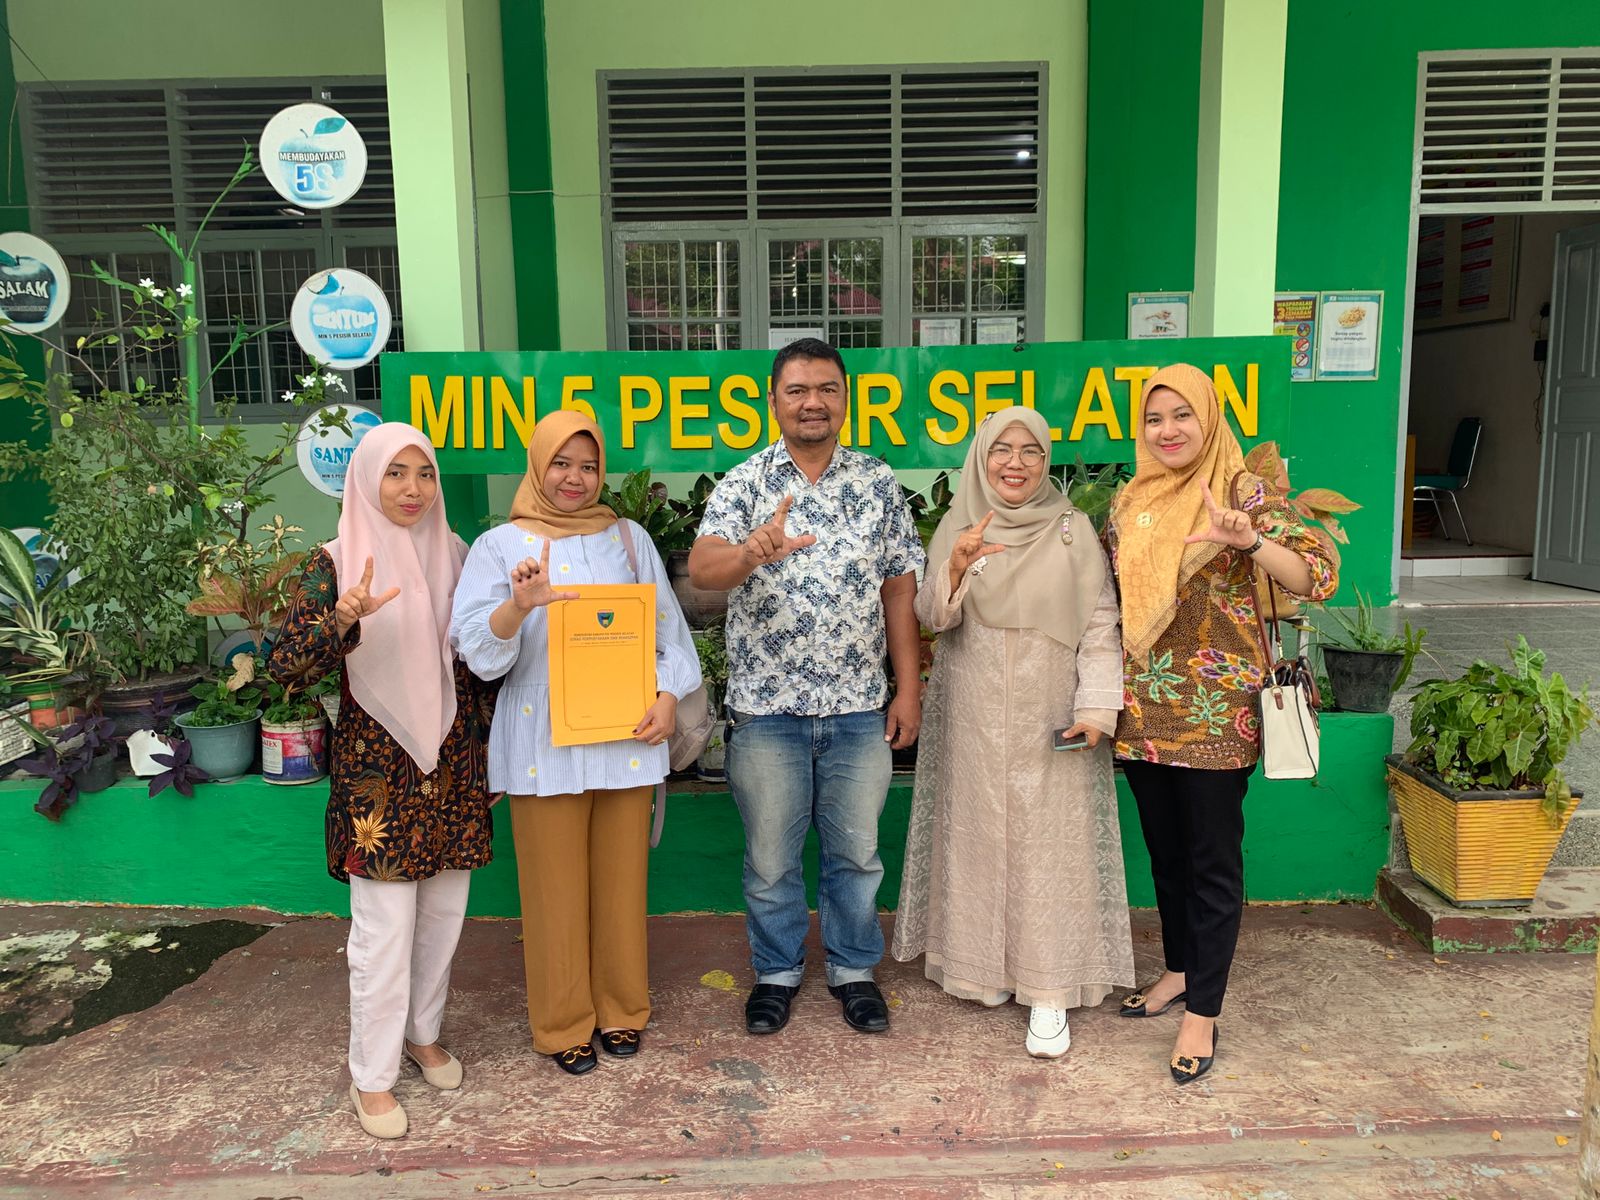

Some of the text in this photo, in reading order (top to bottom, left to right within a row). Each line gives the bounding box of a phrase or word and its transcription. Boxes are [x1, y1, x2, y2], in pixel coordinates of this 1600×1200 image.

[279, 150, 346, 162] MEMBUDAYAKAN
[295, 163, 337, 193] 5S
[0, 280, 49, 299] SALAM
[409, 375, 536, 450] MIN
[620, 374, 907, 451] PESIR
[926, 363, 1260, 446] SELATN
[313, 447, 355, 465] SANT
